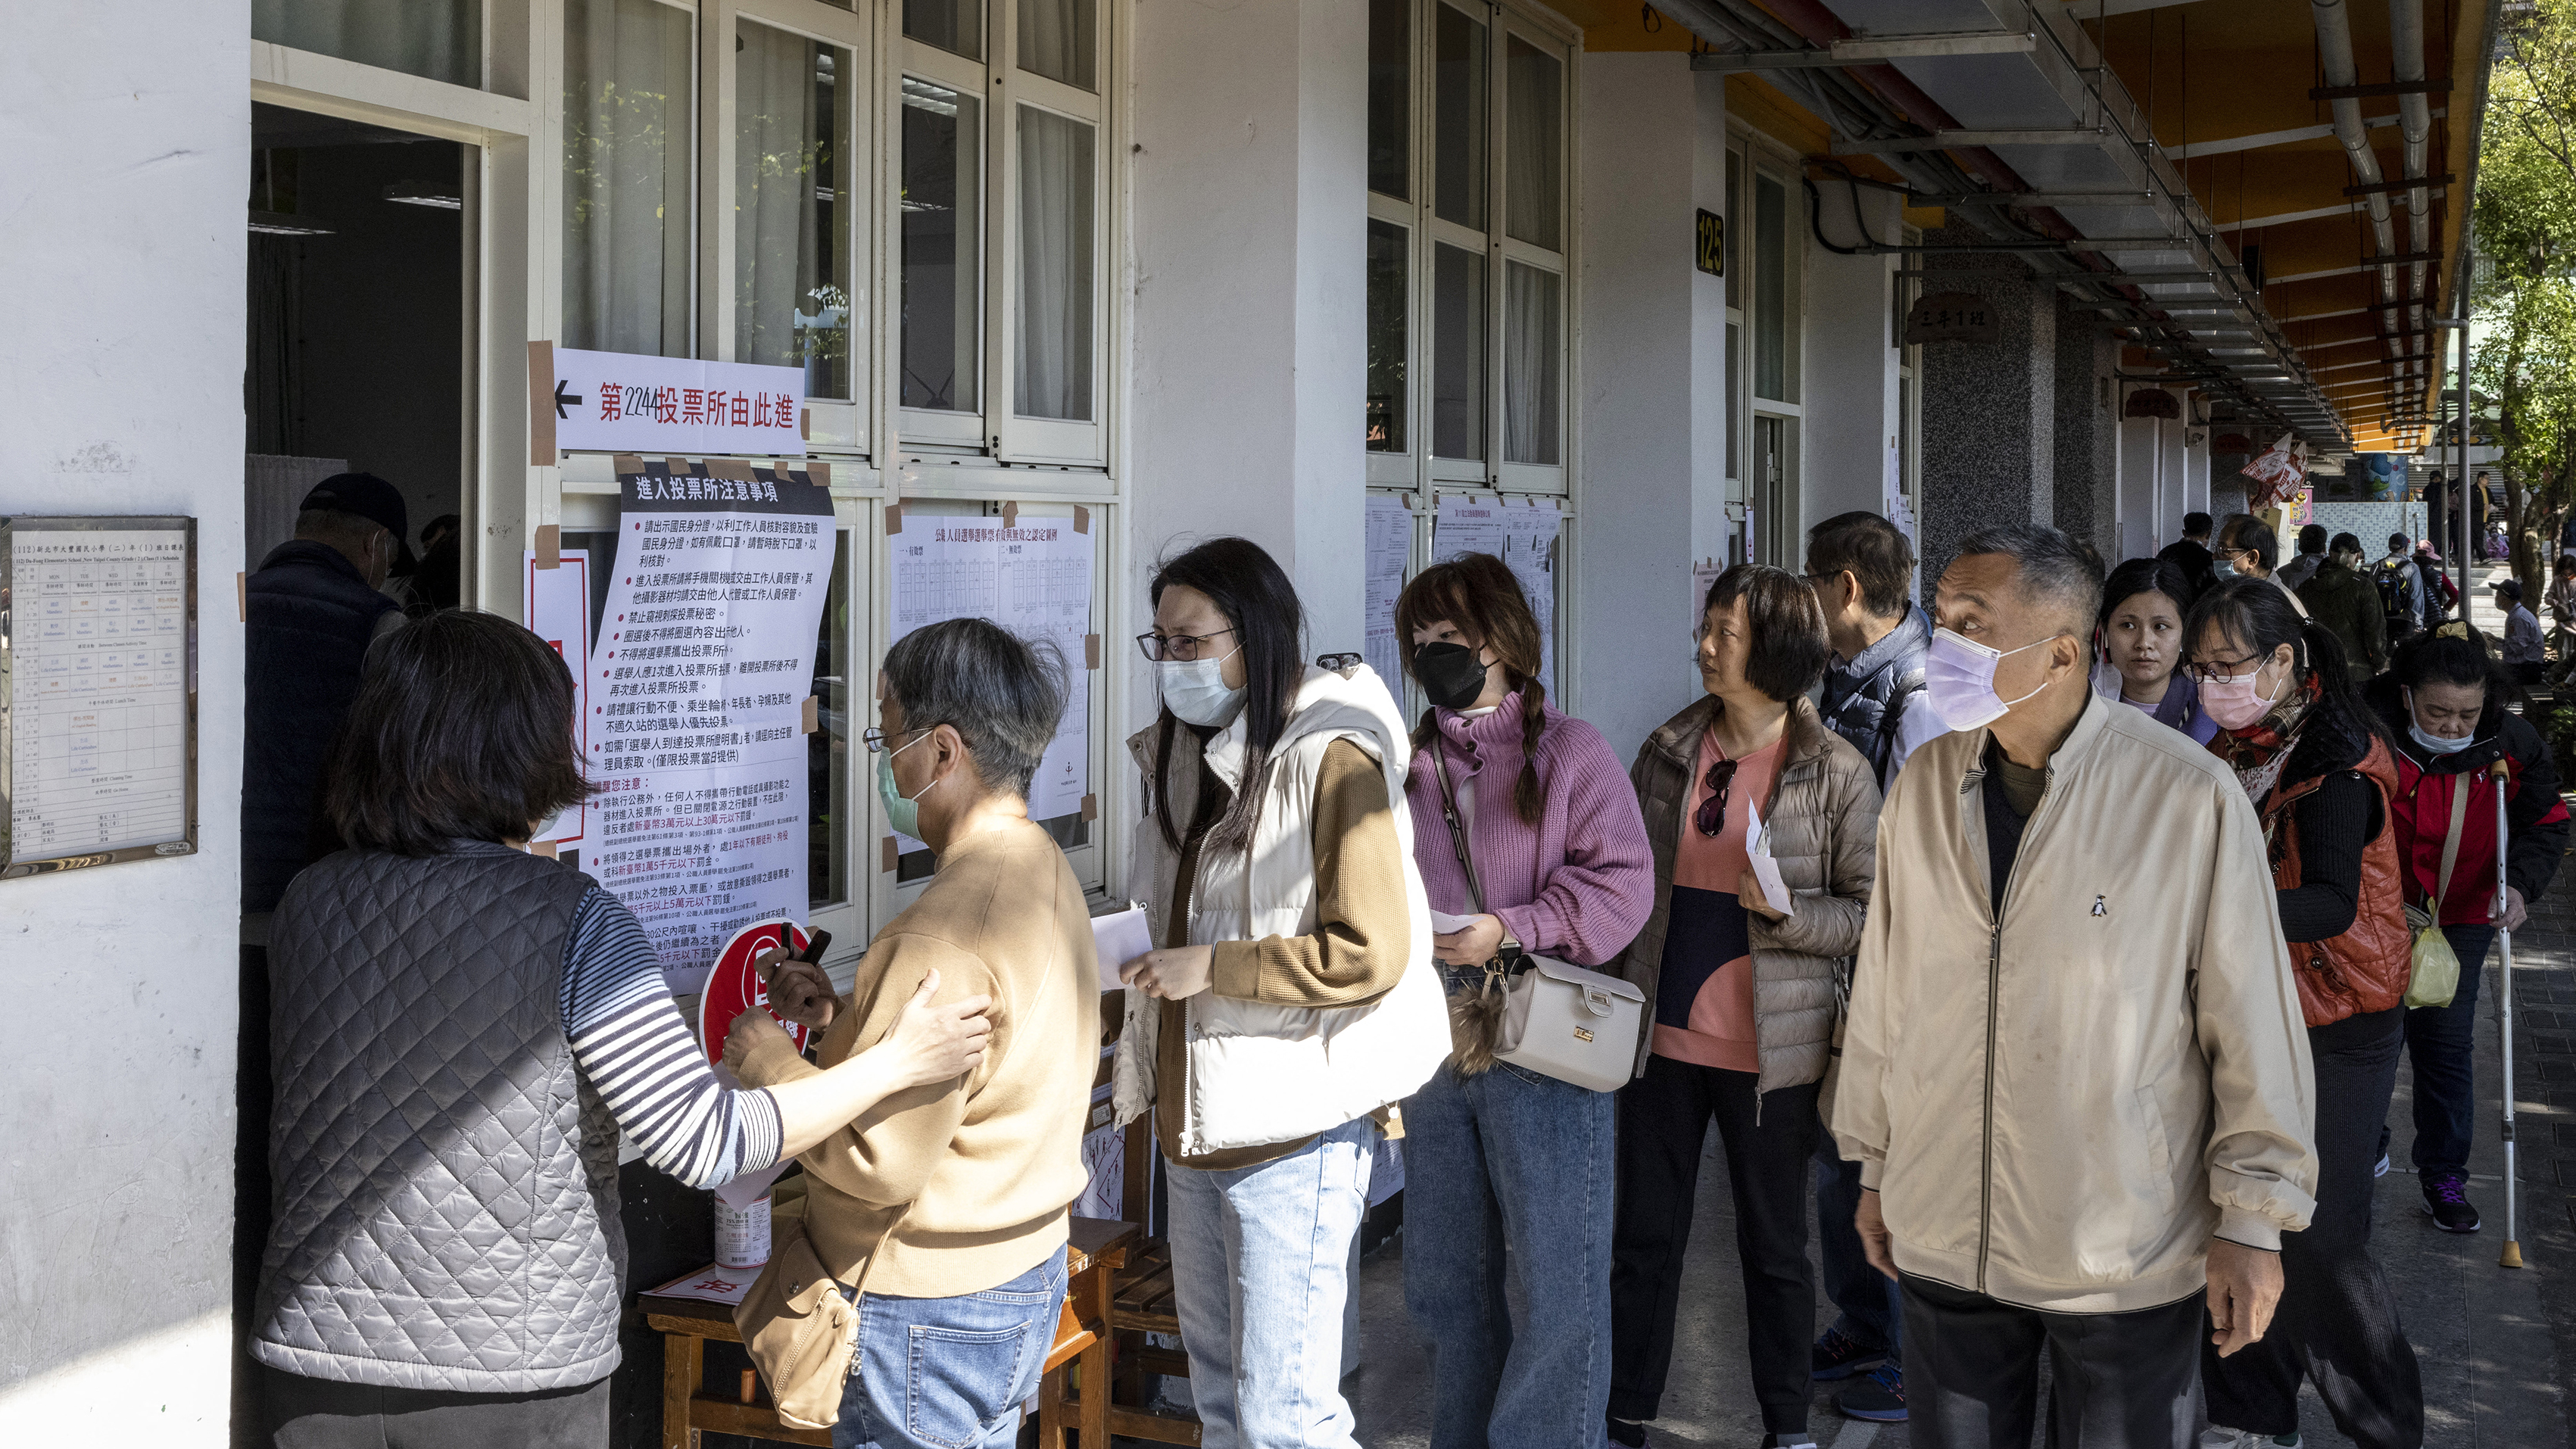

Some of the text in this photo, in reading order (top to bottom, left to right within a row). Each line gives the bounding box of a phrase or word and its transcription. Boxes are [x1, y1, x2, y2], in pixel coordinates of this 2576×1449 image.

[1698, 214, 1723, 271] 125
[636, 476, 778, 503] 進入投票所注意事項
[644, 519, 819, 534] 請出示國民身分證，以利工作人員核對容貌及查驗
[639, 554, 670, 568] 利核對。
[628, 607, 724, 625] 禁止窺視刺探投票秘密。
[610, 681, 706, 697] 再次進入投票所投票。
[606, 715, 733, 734] 不適久站的選舉人優先投票。
[651, 932, 736, 951] 後仍繼續為之者，
[657, 947, 721, 963] 5千元以下罰金
